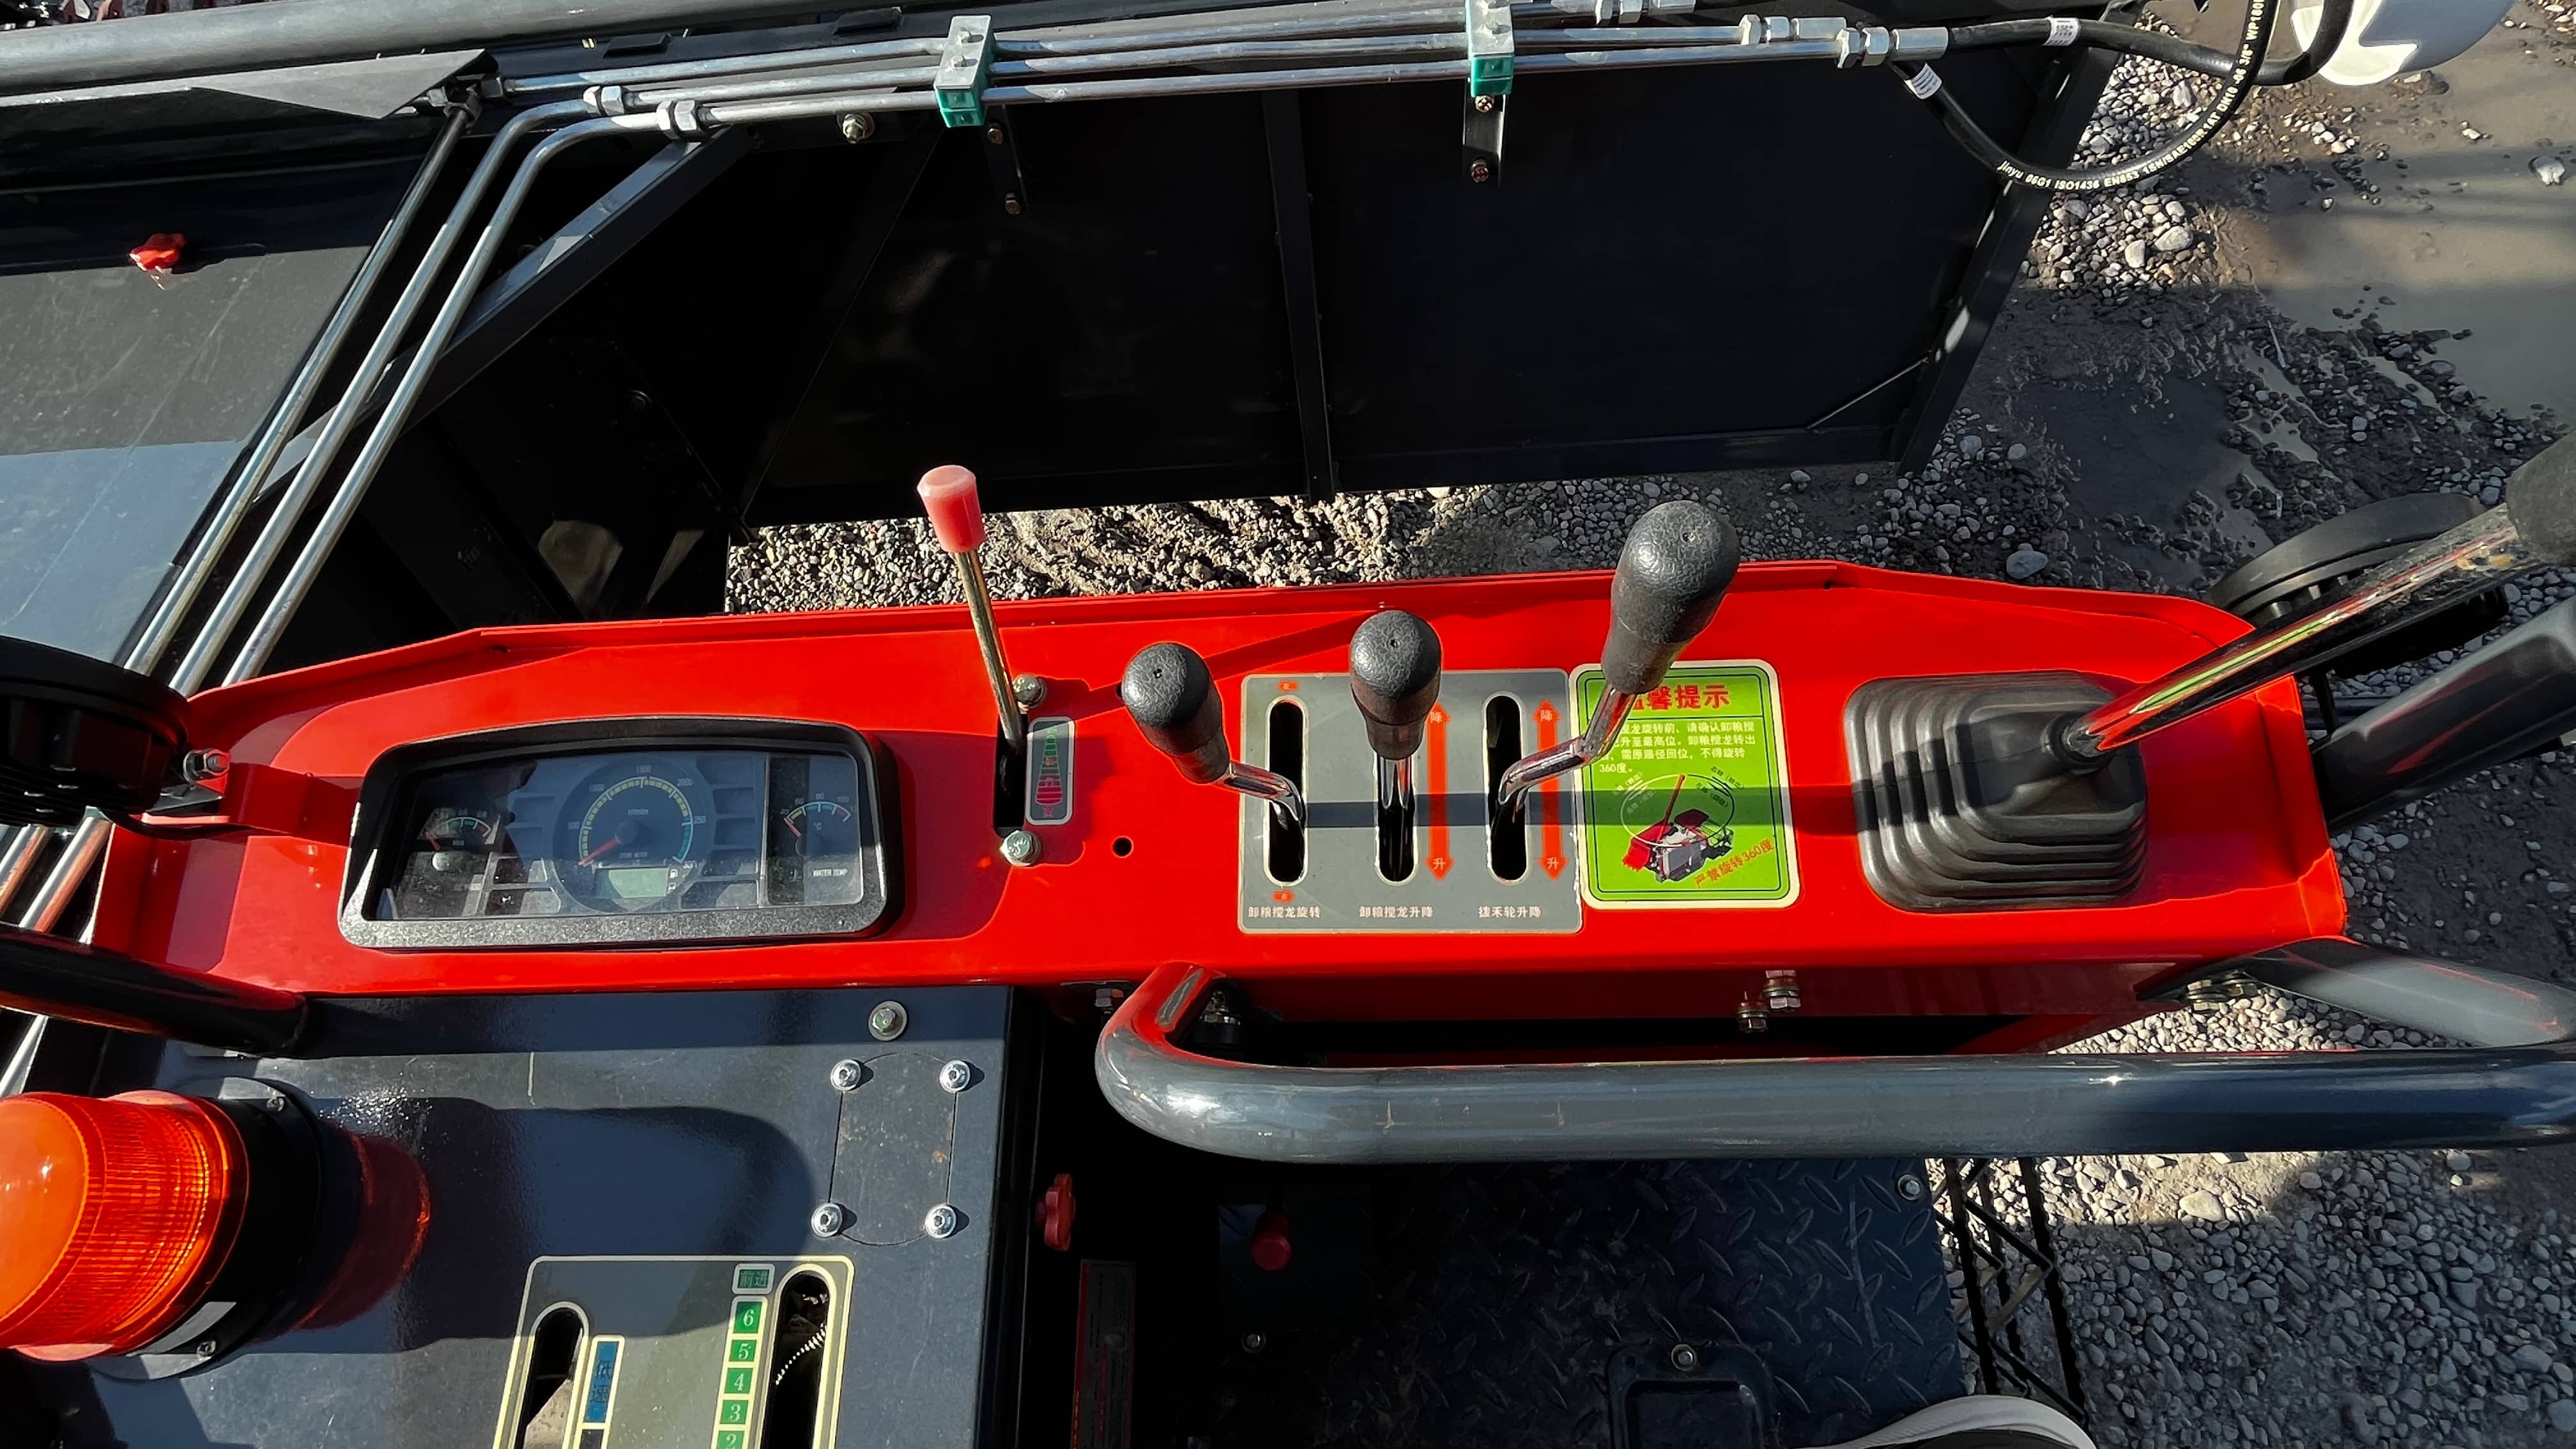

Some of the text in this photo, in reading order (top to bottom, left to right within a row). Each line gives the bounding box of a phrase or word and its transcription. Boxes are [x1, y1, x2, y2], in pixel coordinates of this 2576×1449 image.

[2054, 180, 2100, 190] ISO1436
[1632, 685, 1730, 710] 馨提示
[1433, 857, 1446, 870] 升
[1547, 856, 1560, 870] 升
[742, 1308, 755, 1327] 6
[738, 1343, 751, 1360] 5
[733, 1372, 745, 1392] 4
[729, 1403, 742, 1422] 3
[725, 1433, 737, 1449] 2
